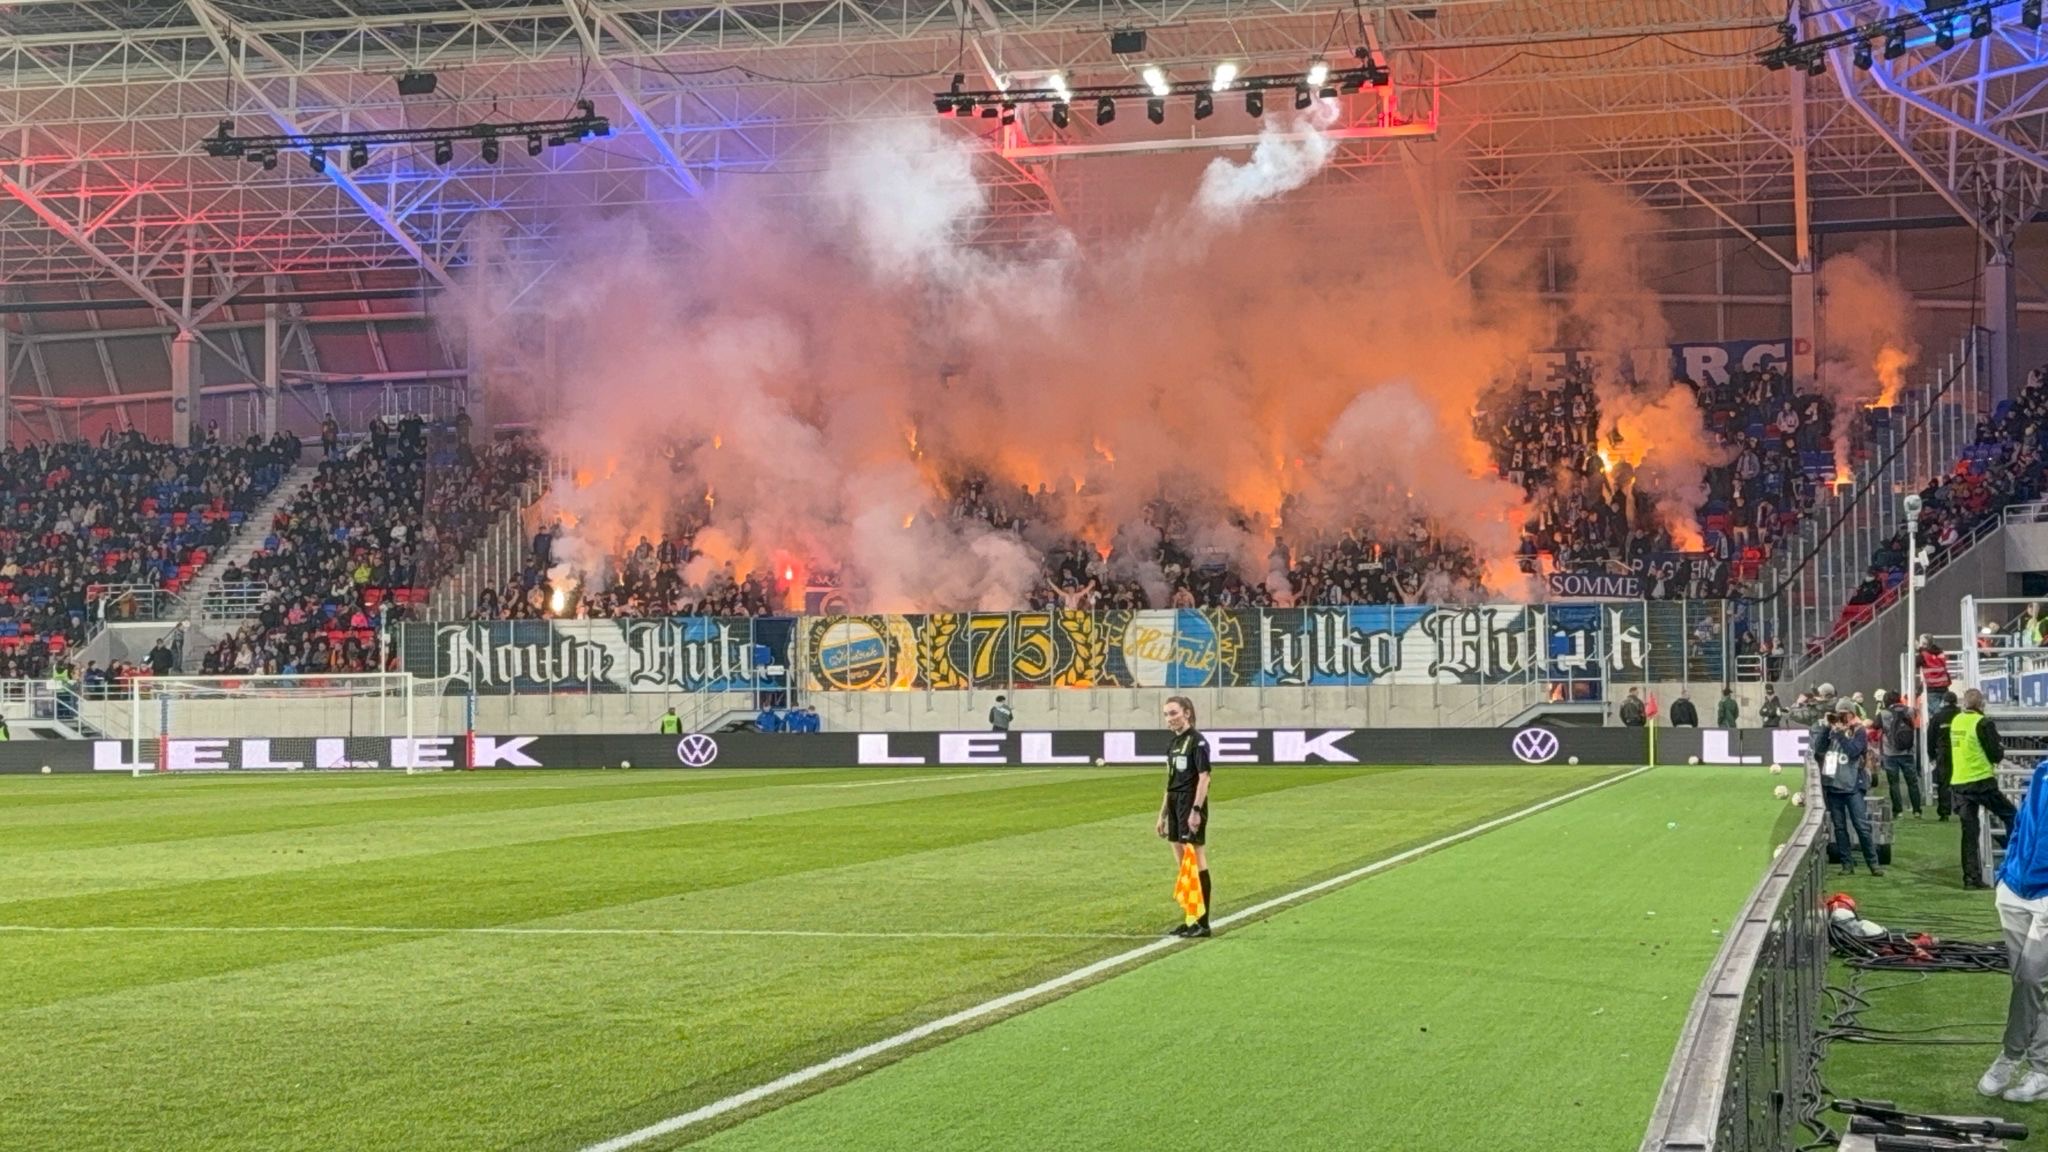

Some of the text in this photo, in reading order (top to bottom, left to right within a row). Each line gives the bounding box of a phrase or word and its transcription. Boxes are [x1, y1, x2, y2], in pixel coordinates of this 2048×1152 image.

[1794, 337, 1811, 355] D
[174, 397, 188, 414] C
[1109, 609, 1132, 647] KLU
[1260, 610, 1400, 684] tylko
[437, 623, 614, 686] Nowa
[963, 614, 1057, 682] 75
[1125, 625, 1216, 671] Hutnik
[93, 736, 543, 771] LELLEK
[857, 731, 1360, 764] LELLEK
